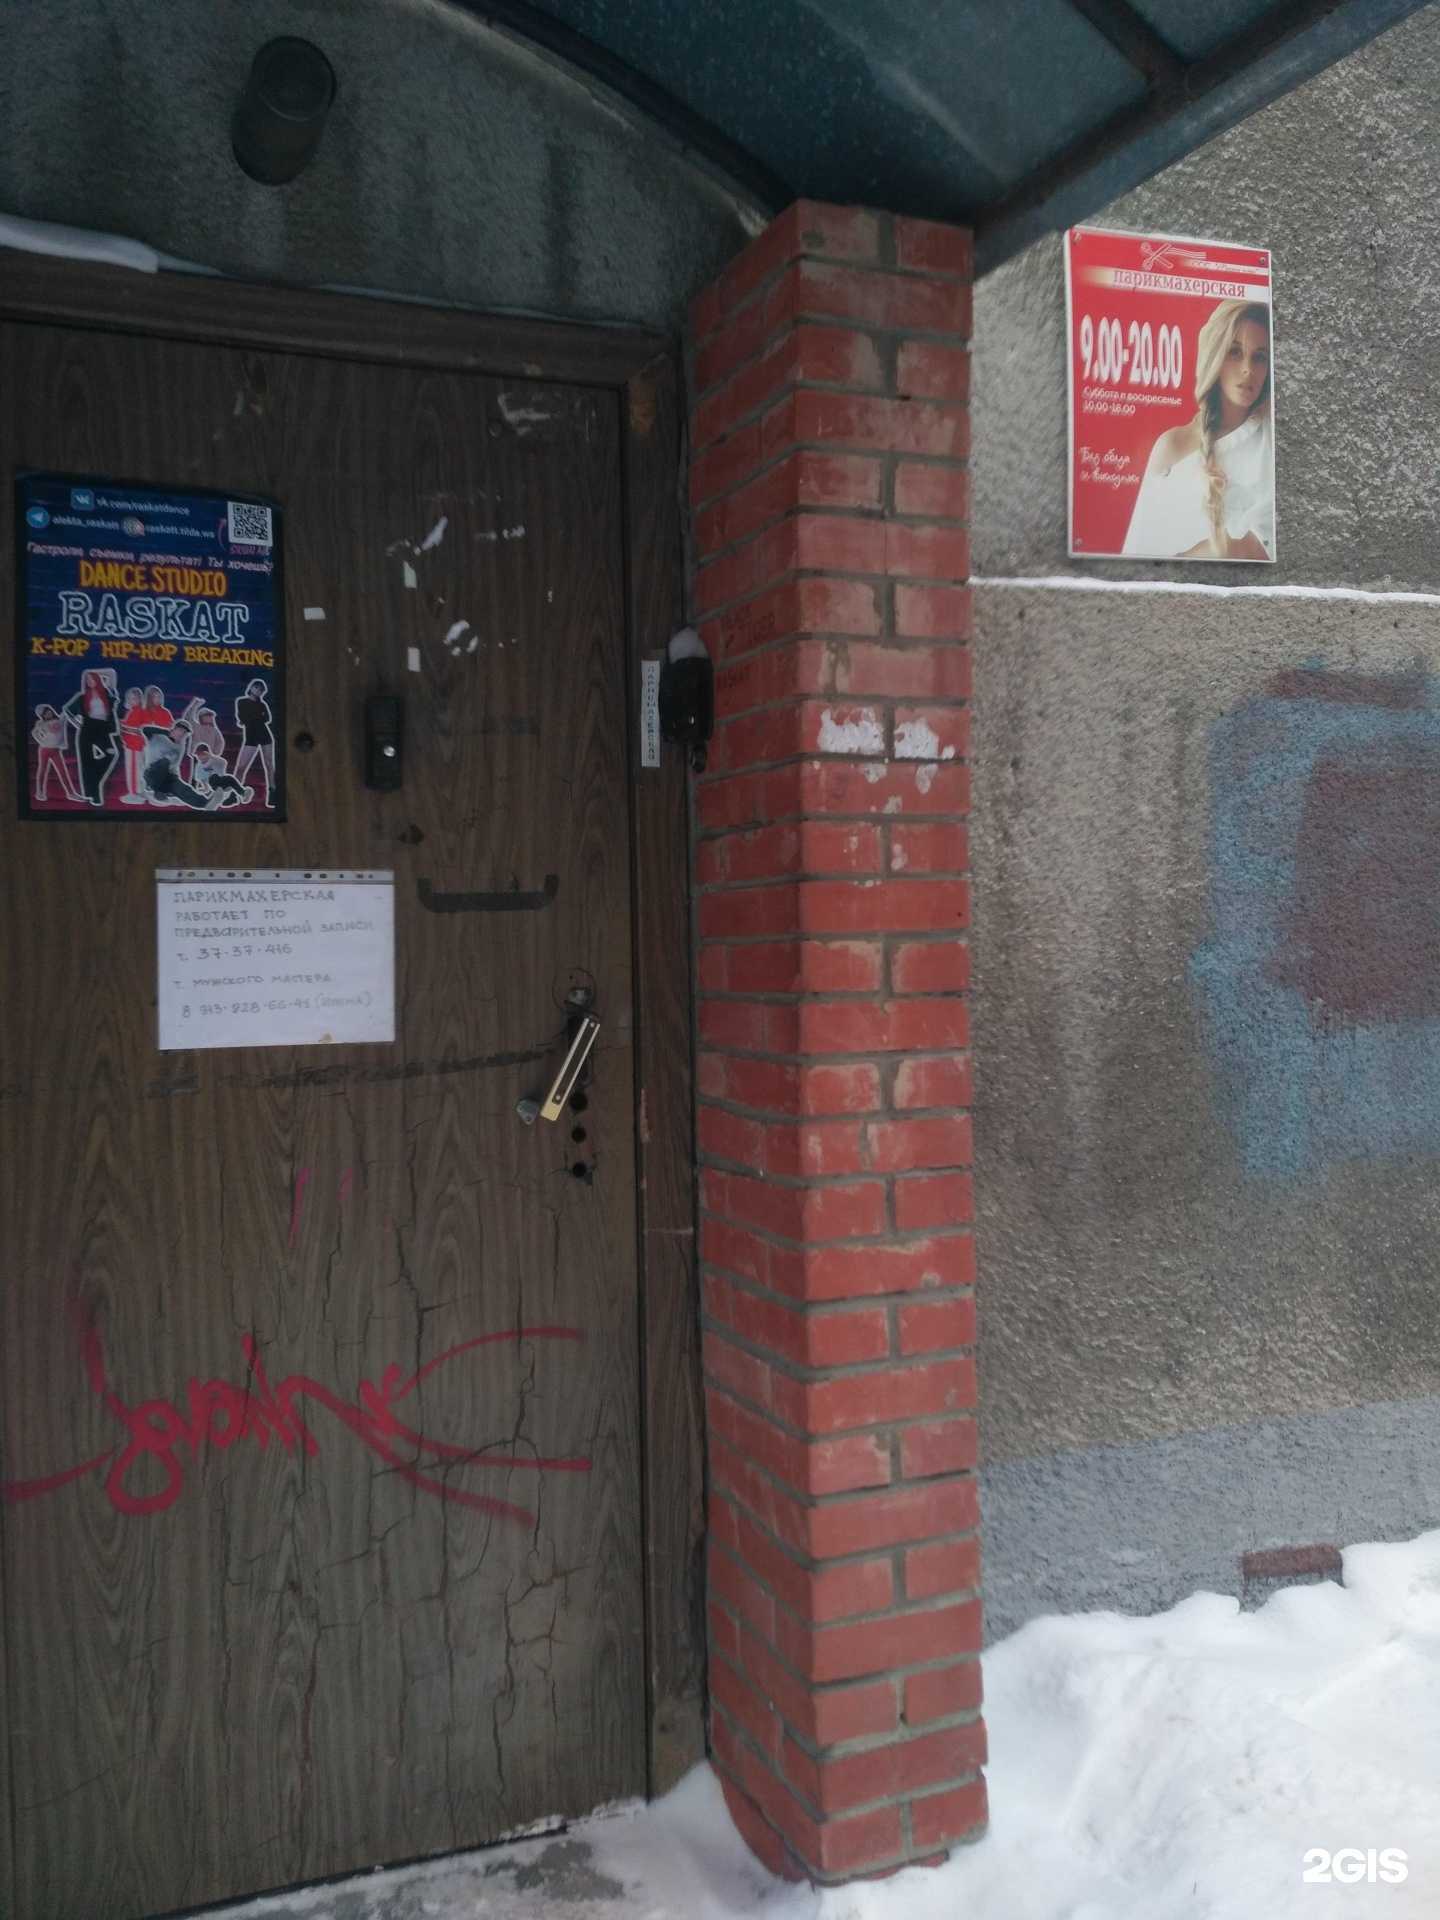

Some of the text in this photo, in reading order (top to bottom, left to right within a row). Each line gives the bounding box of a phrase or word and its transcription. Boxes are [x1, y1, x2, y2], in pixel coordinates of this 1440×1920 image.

[1113, 269, 1246, 298] парикмахерская
[1080, 313, 1183, 389] 9.00-20.00
[208, 556, 224, 567] Ты
[79, 560, 228, 597] DANCE STUDIO
[56, 591, 250, 644] RASKAT
[31, 637, 273, 668] K-POP HIP-HOP BREAKING
[173, 889, 336, 904] ПАРИКМАХЕРСКАЯ
[175, 909, 287, 922] РАБОТАЕТ ПО
